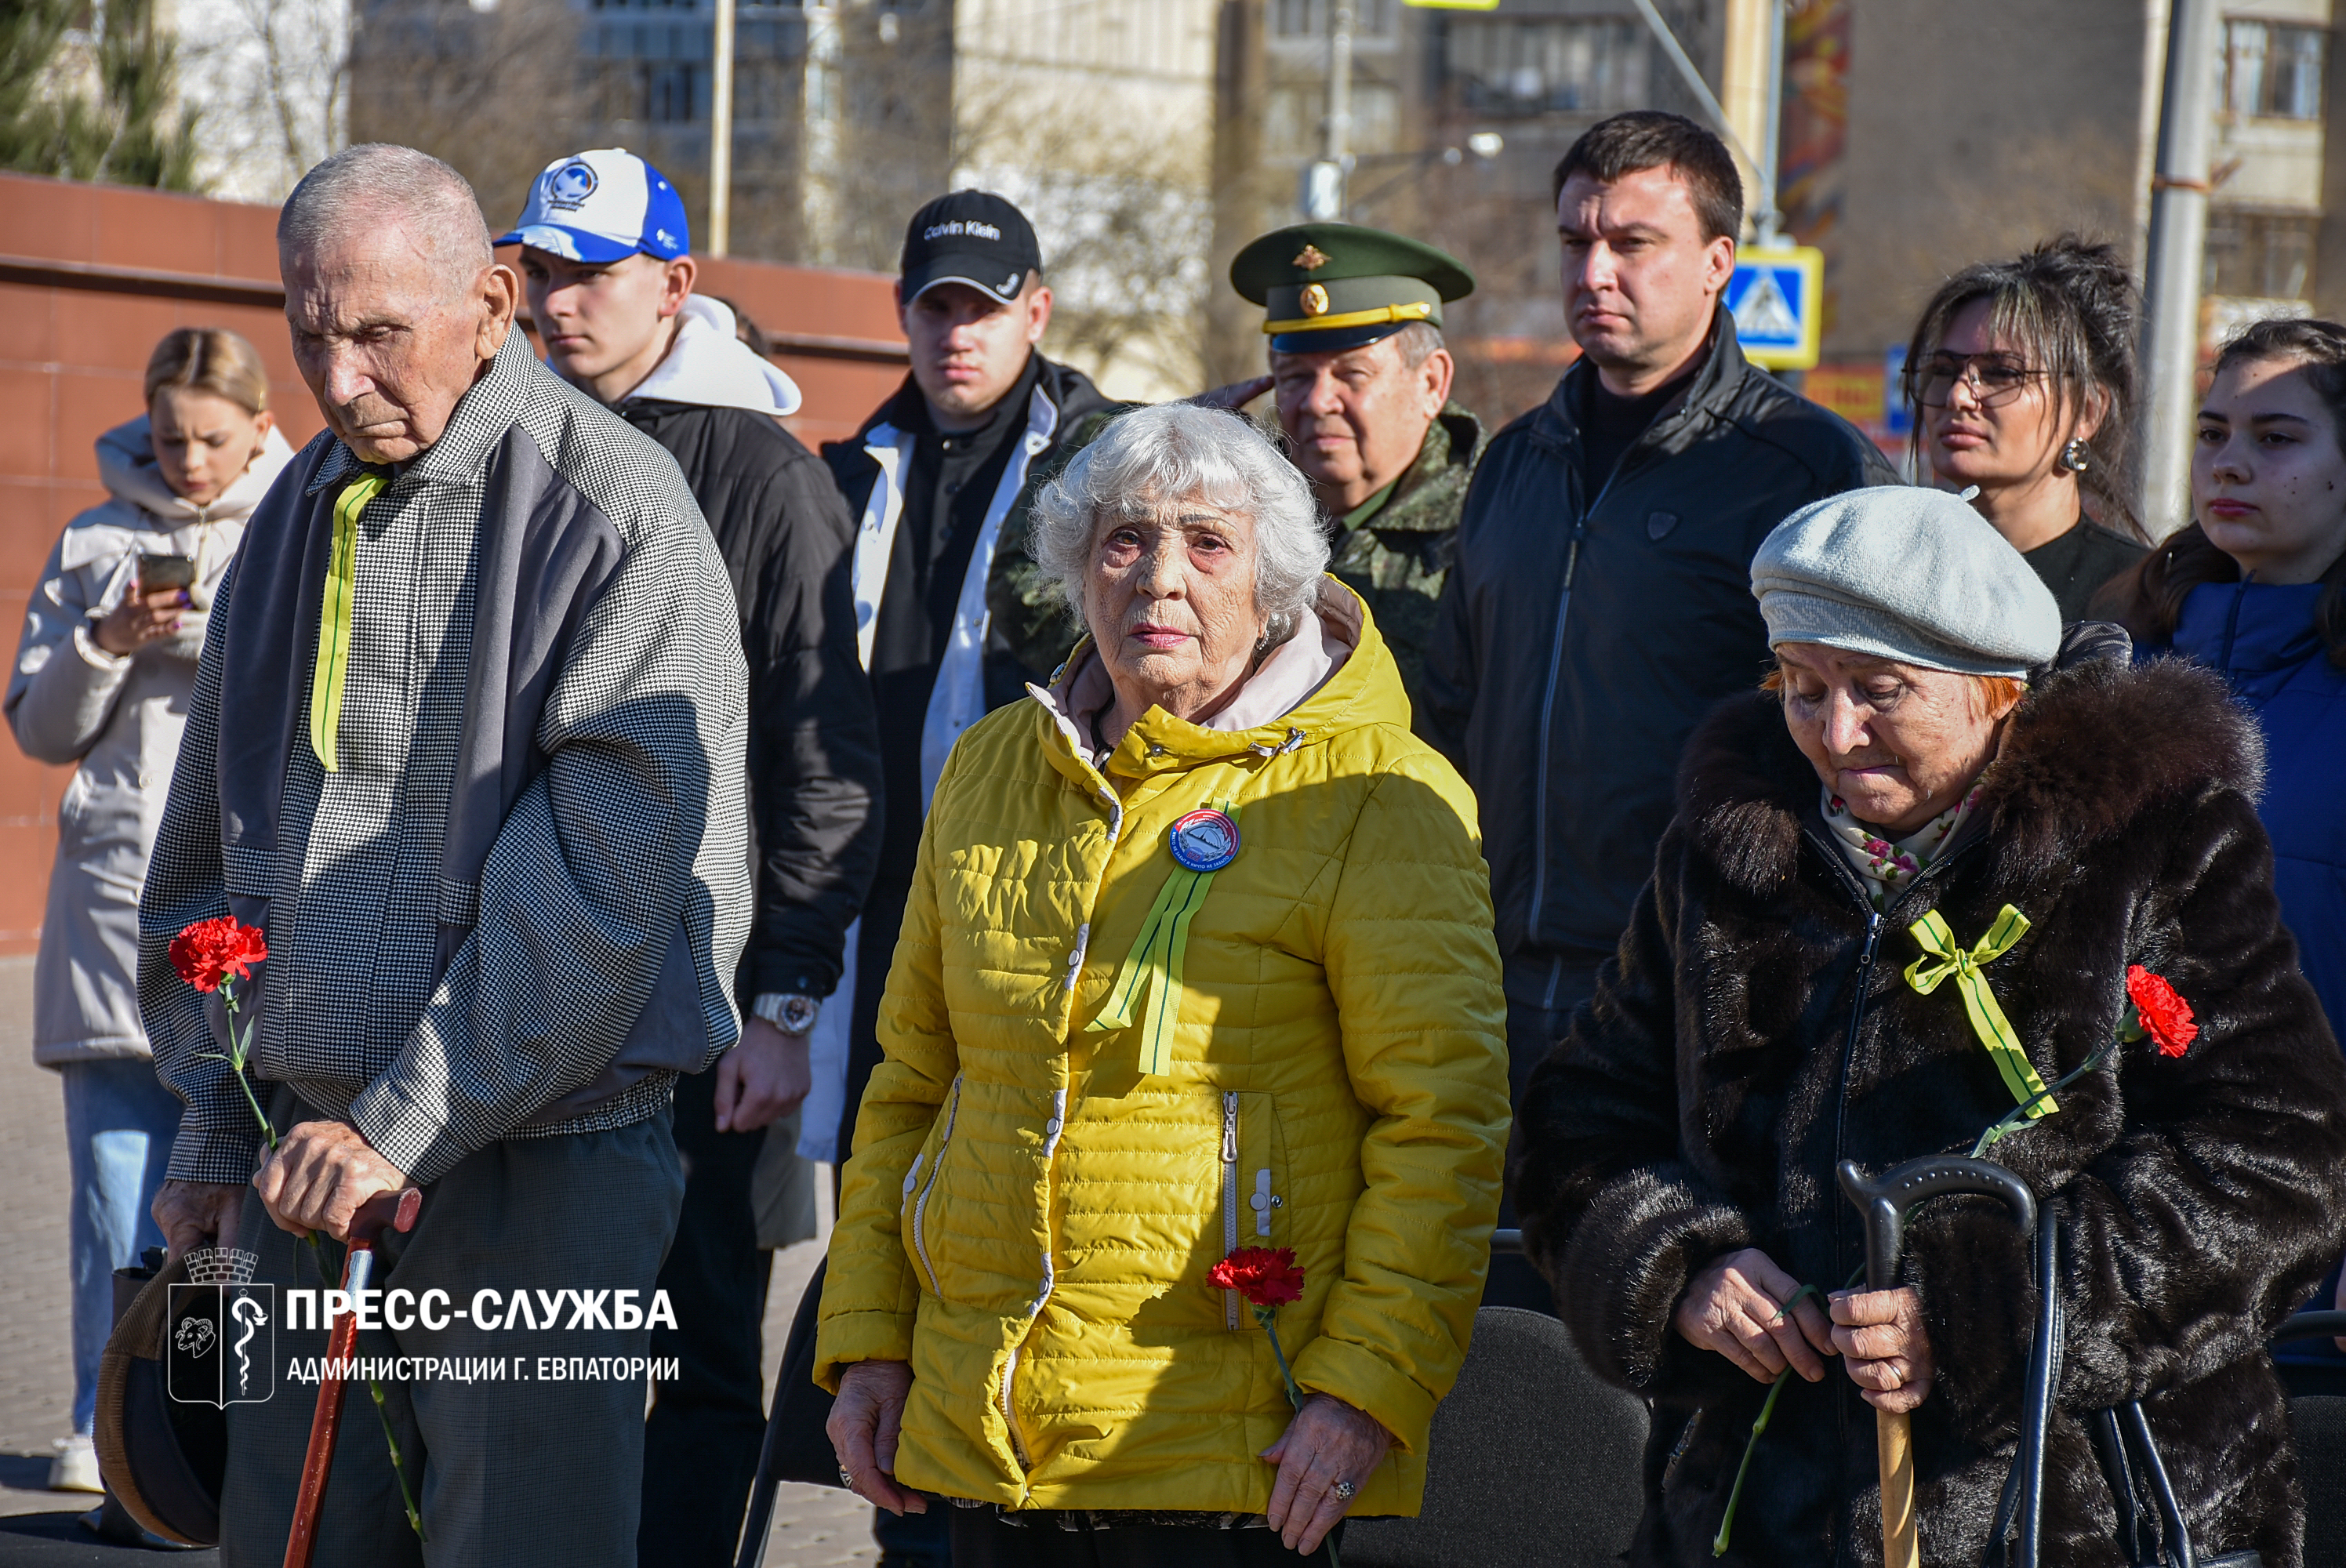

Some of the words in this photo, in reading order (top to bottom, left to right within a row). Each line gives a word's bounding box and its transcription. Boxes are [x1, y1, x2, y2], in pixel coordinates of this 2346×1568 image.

[924, 220, 964, 241] Calvin
[965, 220, 1000, 241] Klein
[1175, 851, 1187, 862] ЗАБЫТ
[1213, 855, 1229, 867] ЗАБЫТО
